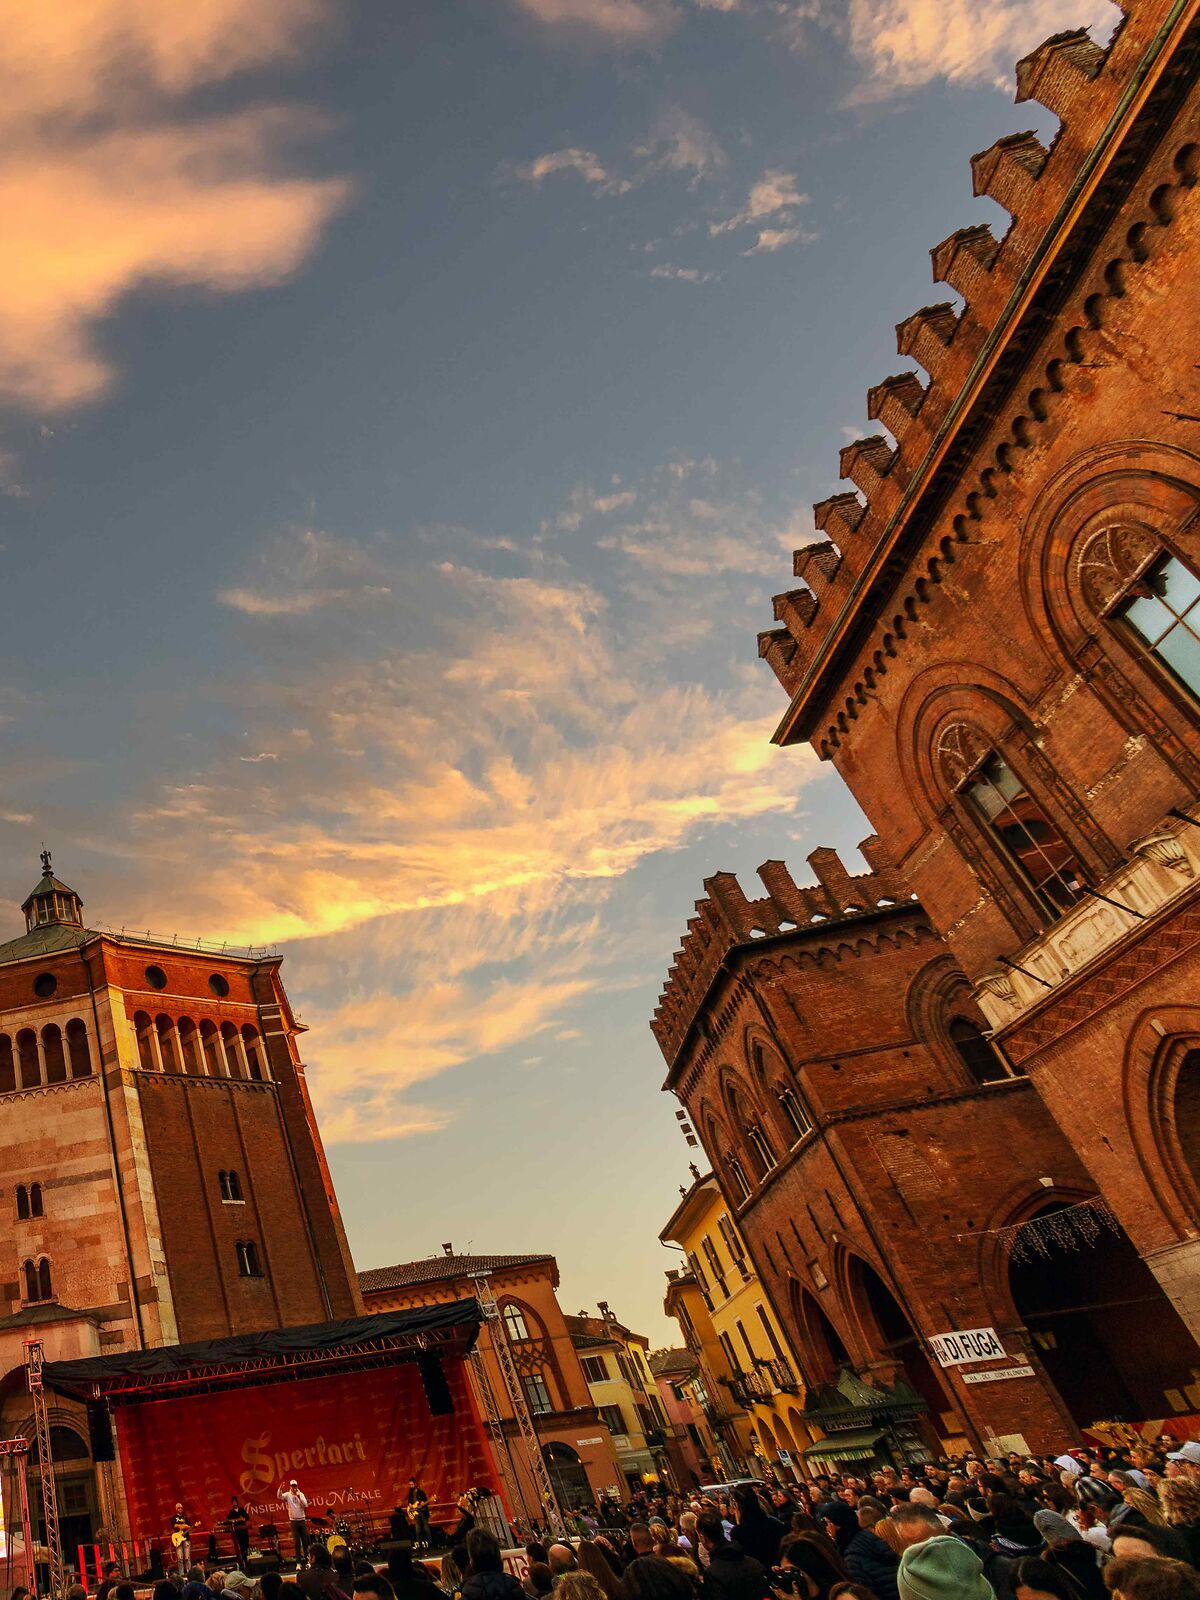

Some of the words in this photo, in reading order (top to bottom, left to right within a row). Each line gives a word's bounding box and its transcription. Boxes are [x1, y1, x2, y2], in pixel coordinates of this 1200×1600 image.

[942, 1337, 964, 1360] DI
[962, 1332, 1004, 1358] FUGA
[244, 1502, 290, 1515] INSIEM
[326, 1489, 382, 1507] NATALE
